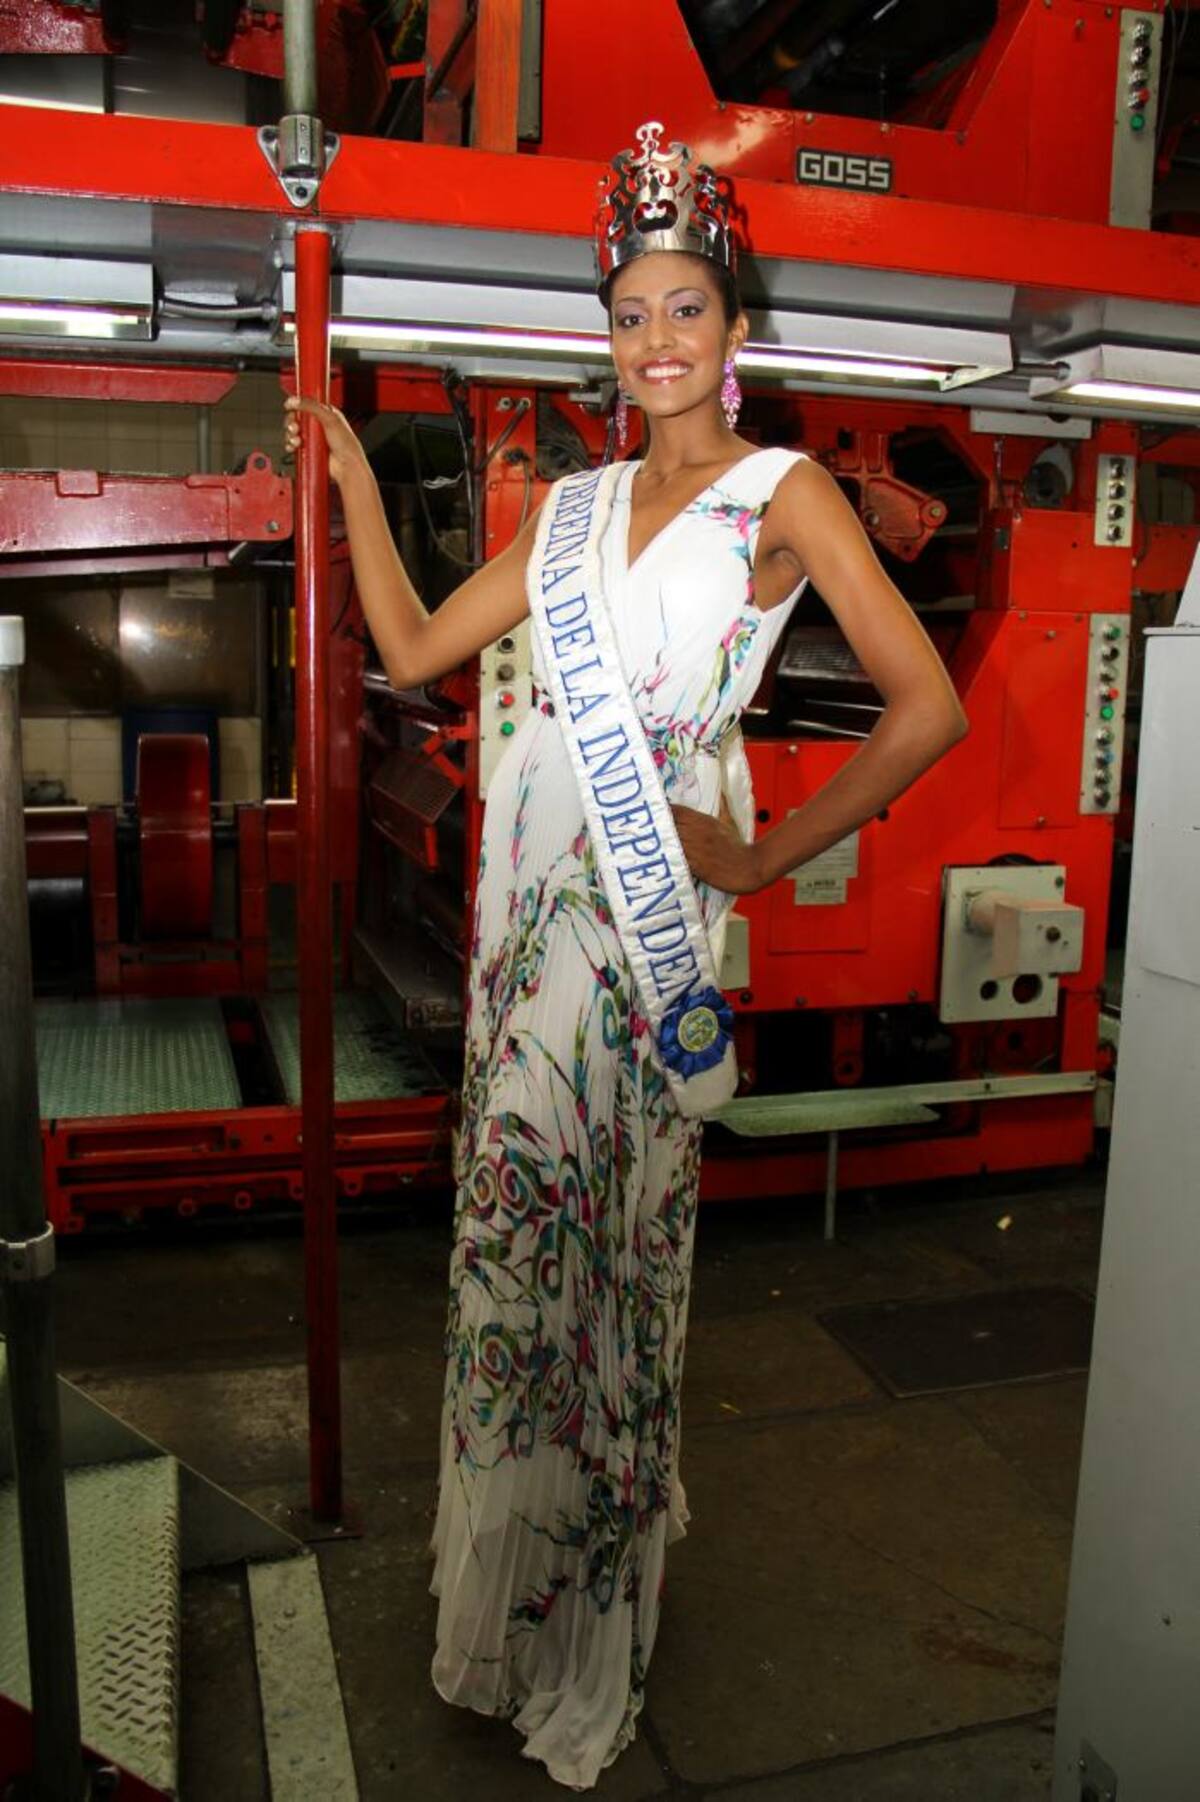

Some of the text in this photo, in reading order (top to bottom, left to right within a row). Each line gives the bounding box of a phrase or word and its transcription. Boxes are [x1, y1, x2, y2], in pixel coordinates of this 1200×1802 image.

[800, 152, 890, 188] GOSS
[545, 591, 596, 659] DE
[559, 654, 611, 724] LA
